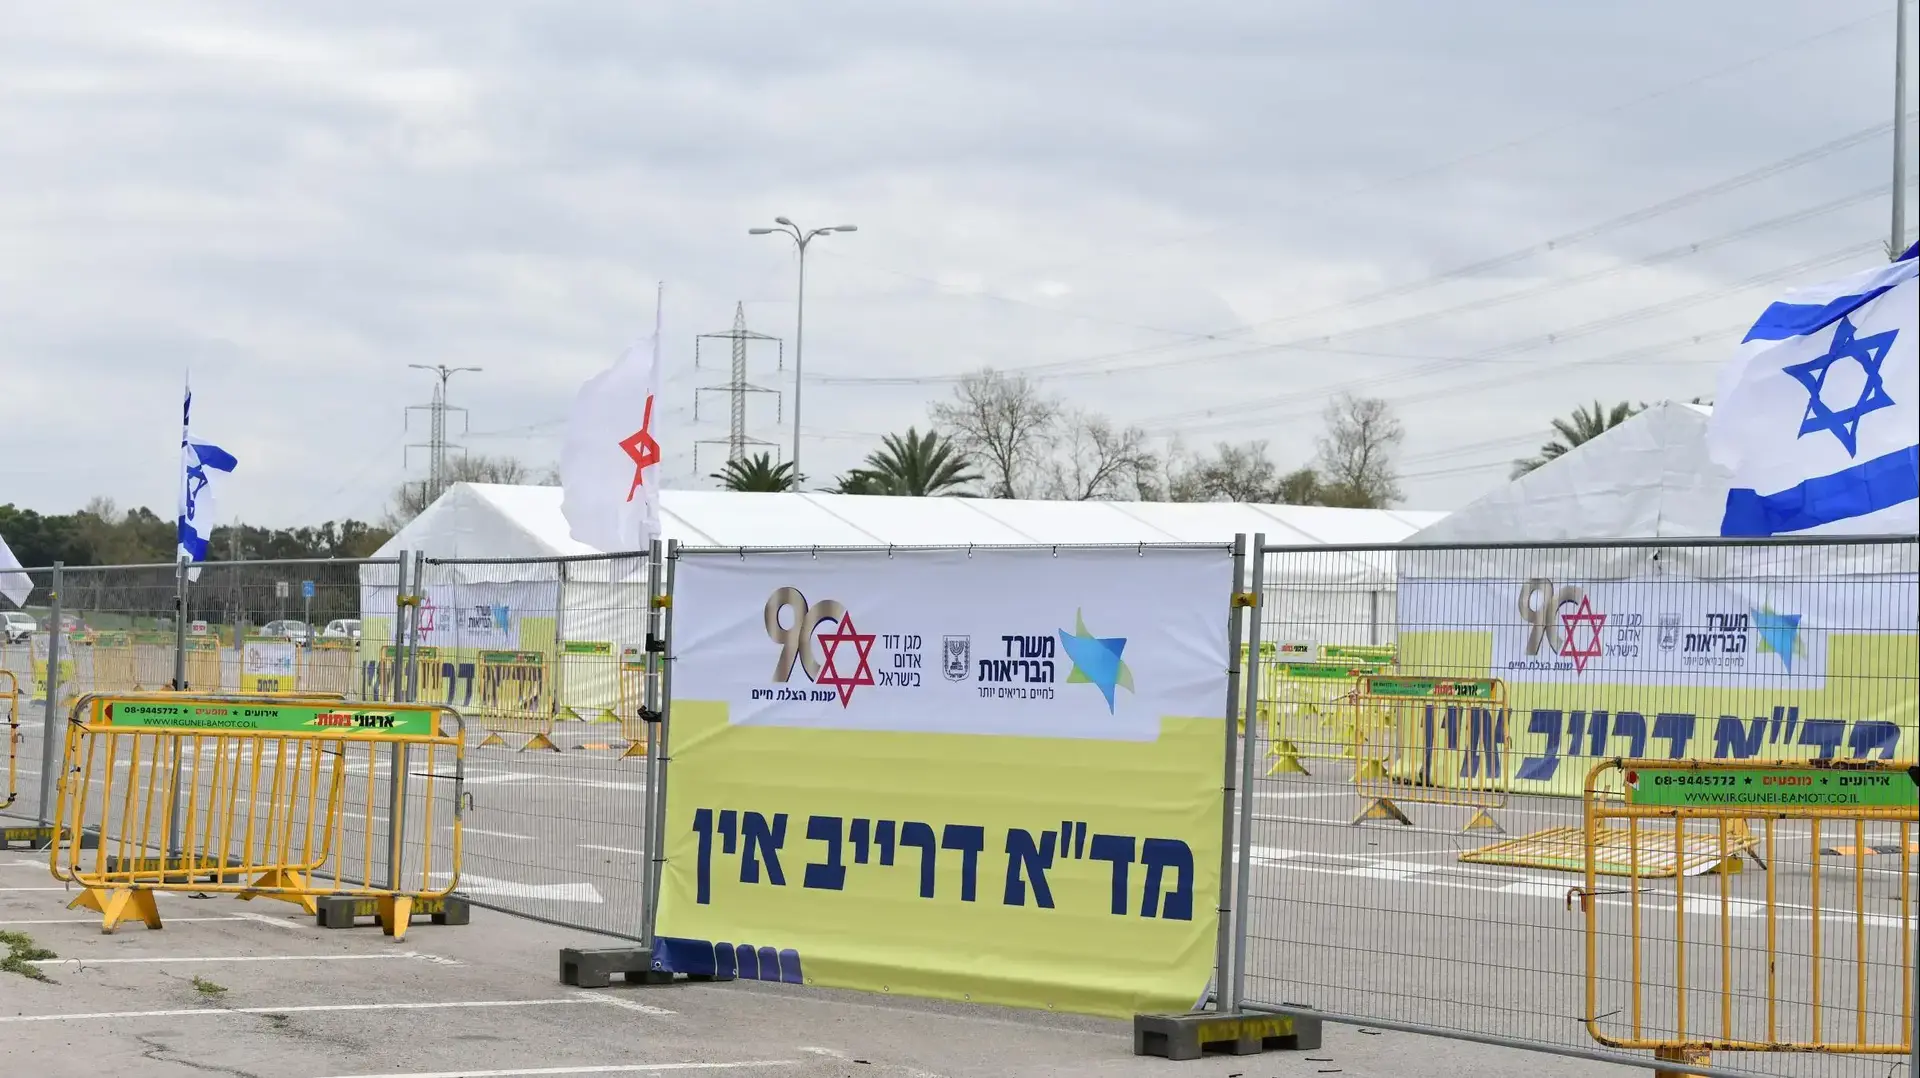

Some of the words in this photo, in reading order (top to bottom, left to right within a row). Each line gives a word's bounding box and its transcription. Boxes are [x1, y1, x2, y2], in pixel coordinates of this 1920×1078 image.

[1706, 613, 1748, 632] משרד
[882, 634, 900, 649] דוד
[1618, 629, 1640, 641] אדום
[903, 635, 922, 652] מגן
[1002, 635, 1055, 658] משרד
[1684, 633, 1747, 652] הבריאות
[1605, 643, 1639, 657] בישראל
[894, 653, 922, 668] אדום
[878, 669, 921, 687] בישראל
[978, 659, 1055, 683] הבריאות
[752, 689, 774, 700] חיים
[776, 688, 807, 701] הצלת
[810, 690, 836, 702] שנות
[978, 687, 996, 698] יותר
[998, 687, 1027, 699] בריאים
[1030, 687, 1054, 699] לחיים
[124, 706, 179, 715] 08-9445772
[355, 714, 395, 728] ארגוני
[1514, 708, 1695, 780] דרייב
[1654, 776, 1736, 786] 08-9445772
[1839, 776, 1891, 786] אירועים
[692, 808, 789, 905] אין
[803, 815, 984, 902] דרייב
[1003, 820, 1195, 921] מד"א
